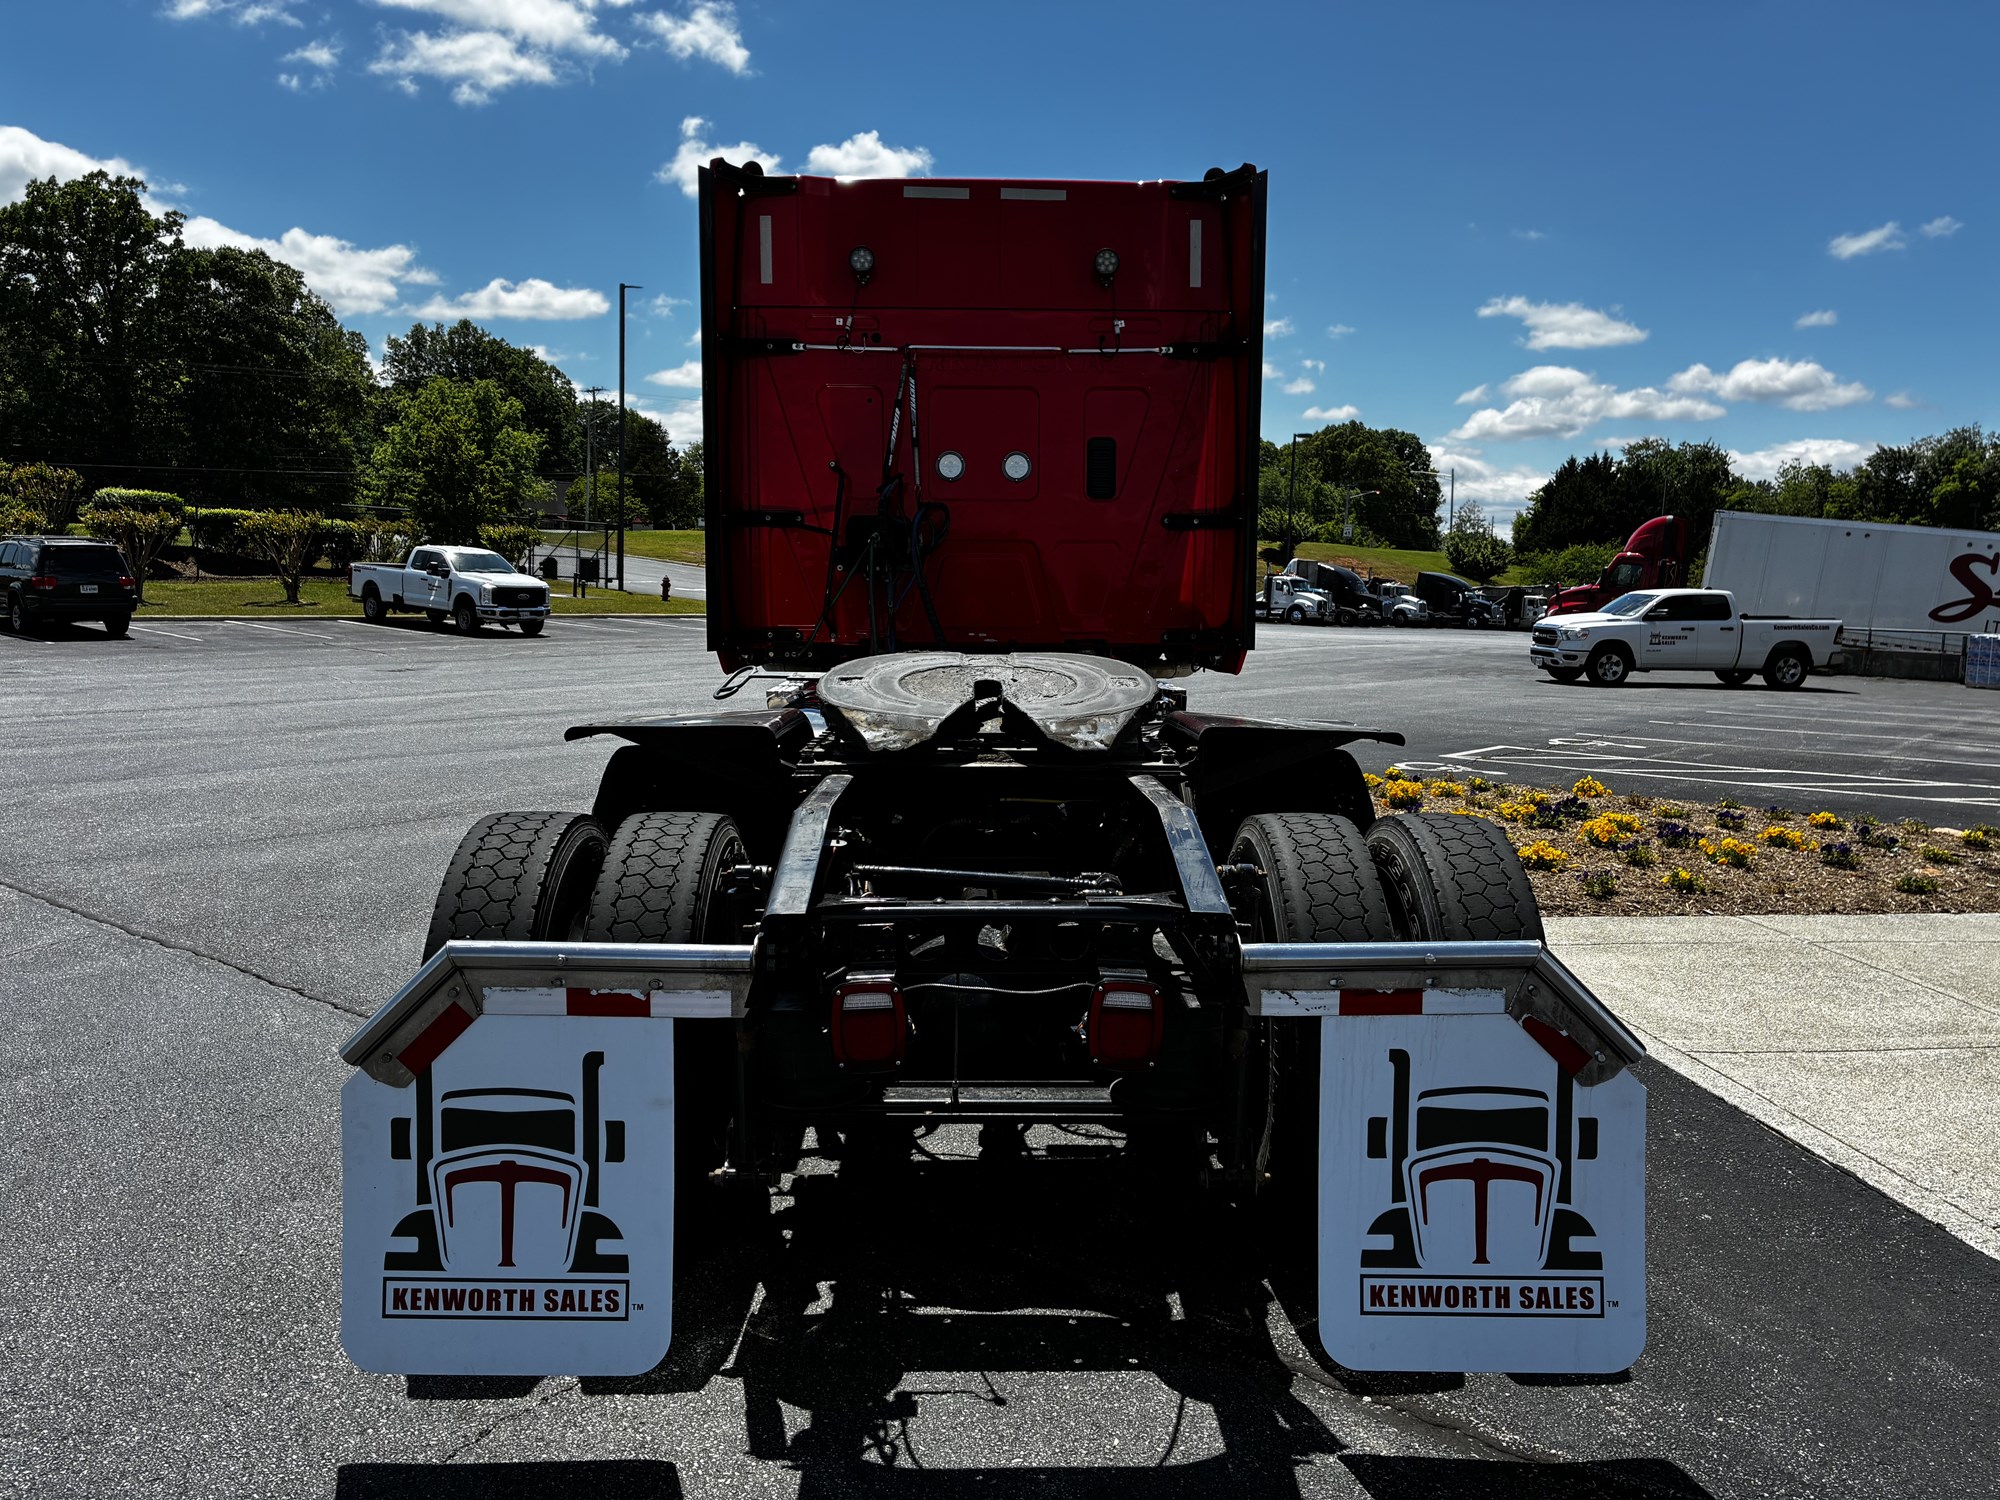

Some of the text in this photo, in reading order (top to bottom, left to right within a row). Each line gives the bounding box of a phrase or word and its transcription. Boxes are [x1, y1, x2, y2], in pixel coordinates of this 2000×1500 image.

[909, 376, 917, 413] TRACKER
[891, 407, 901, 441] TRACKER
[1928, 552, 2000, 623] S
[392, 1287, 535, 1312] KENWORTH
[543, 1289, 620, 1313] SALES
[1369, 1284, 1511, 1308] KENWORTH
[1519, 1286, 1595, 1310] SALES
